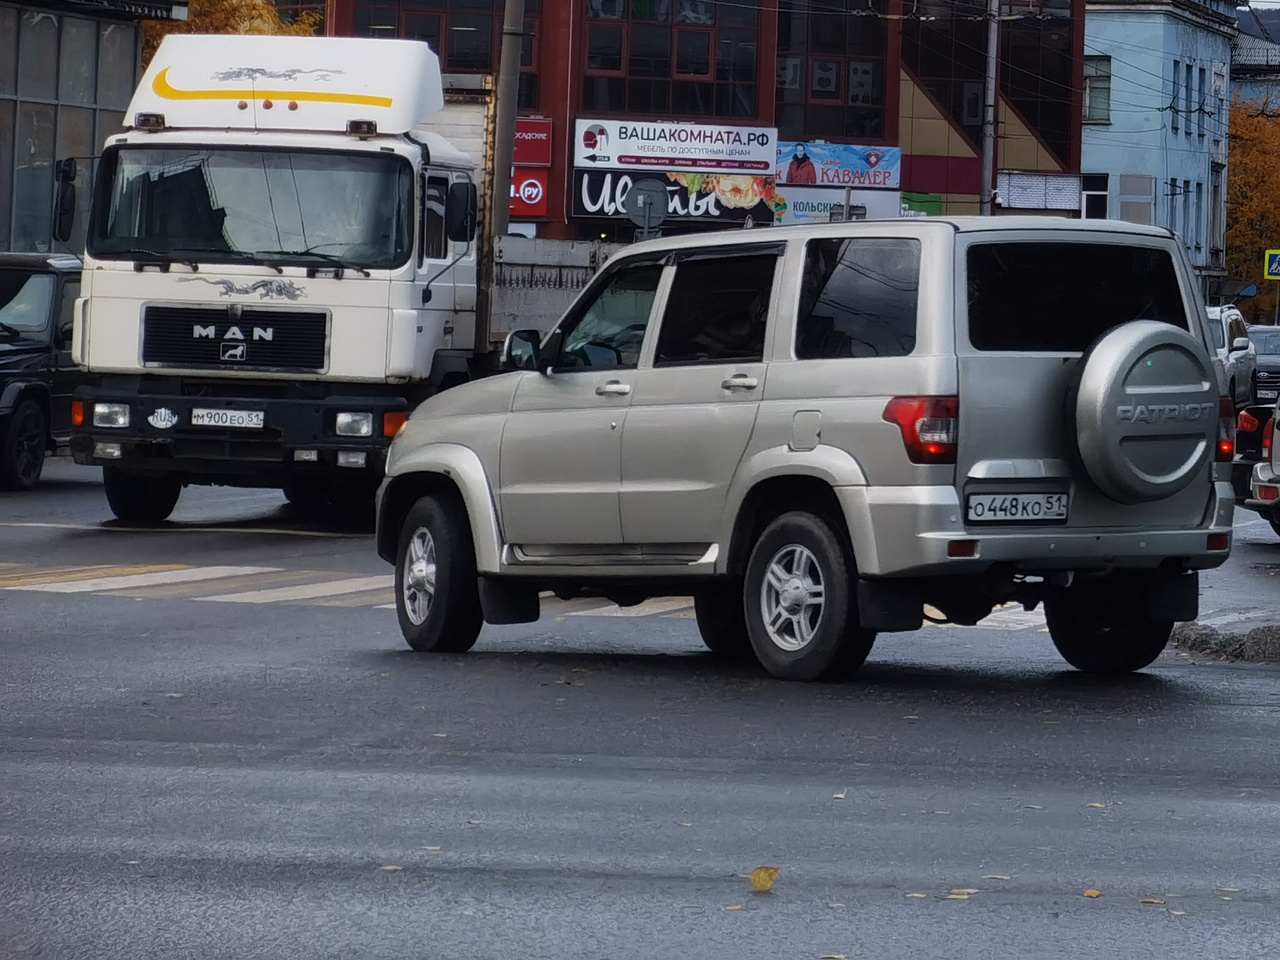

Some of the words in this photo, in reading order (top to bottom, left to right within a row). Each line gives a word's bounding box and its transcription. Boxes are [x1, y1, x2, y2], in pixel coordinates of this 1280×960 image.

[618, 126, 770, 147] ВАШАКОМНАТА.РФ
[636, 144, 666, 154] МЕБЕЛЬ
[667, 146, 678, 154] ПО
[679, 146, 724, 156] ДОСТУПНЫМ
[725, 148, 751, 157] ЦЕНАМ
[820, 167, 892, 186] КАВАЛЕР
[582, 172, 720, 216] Цеты
[792, 200, 842, 214] КОЛЬСКИ
[193, 325, 273, 341] MAN
[1116, 402, 1214, 423] PATRIOT
